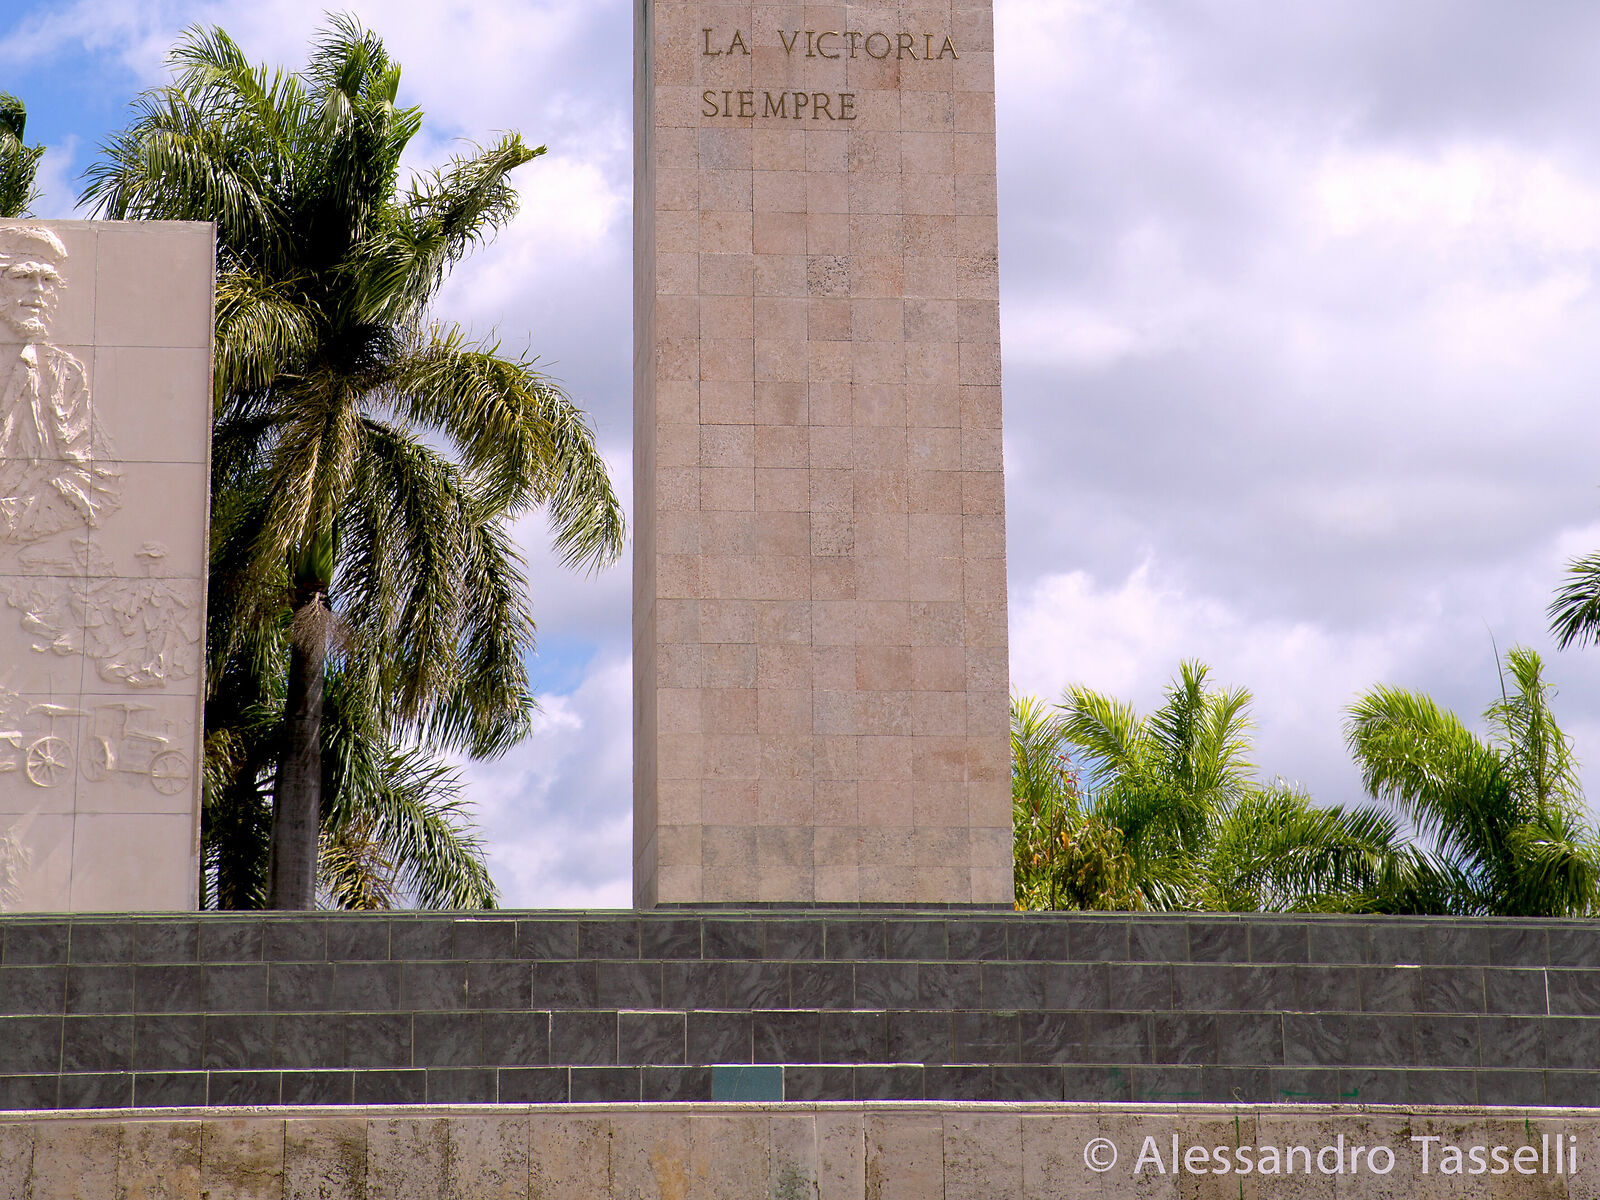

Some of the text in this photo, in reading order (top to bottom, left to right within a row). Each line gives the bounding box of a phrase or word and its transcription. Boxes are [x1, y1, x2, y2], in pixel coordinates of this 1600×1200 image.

[702, 28, 960, 61] LA VICTORIA
[702, 90, 858, 121] SIEMPRE
